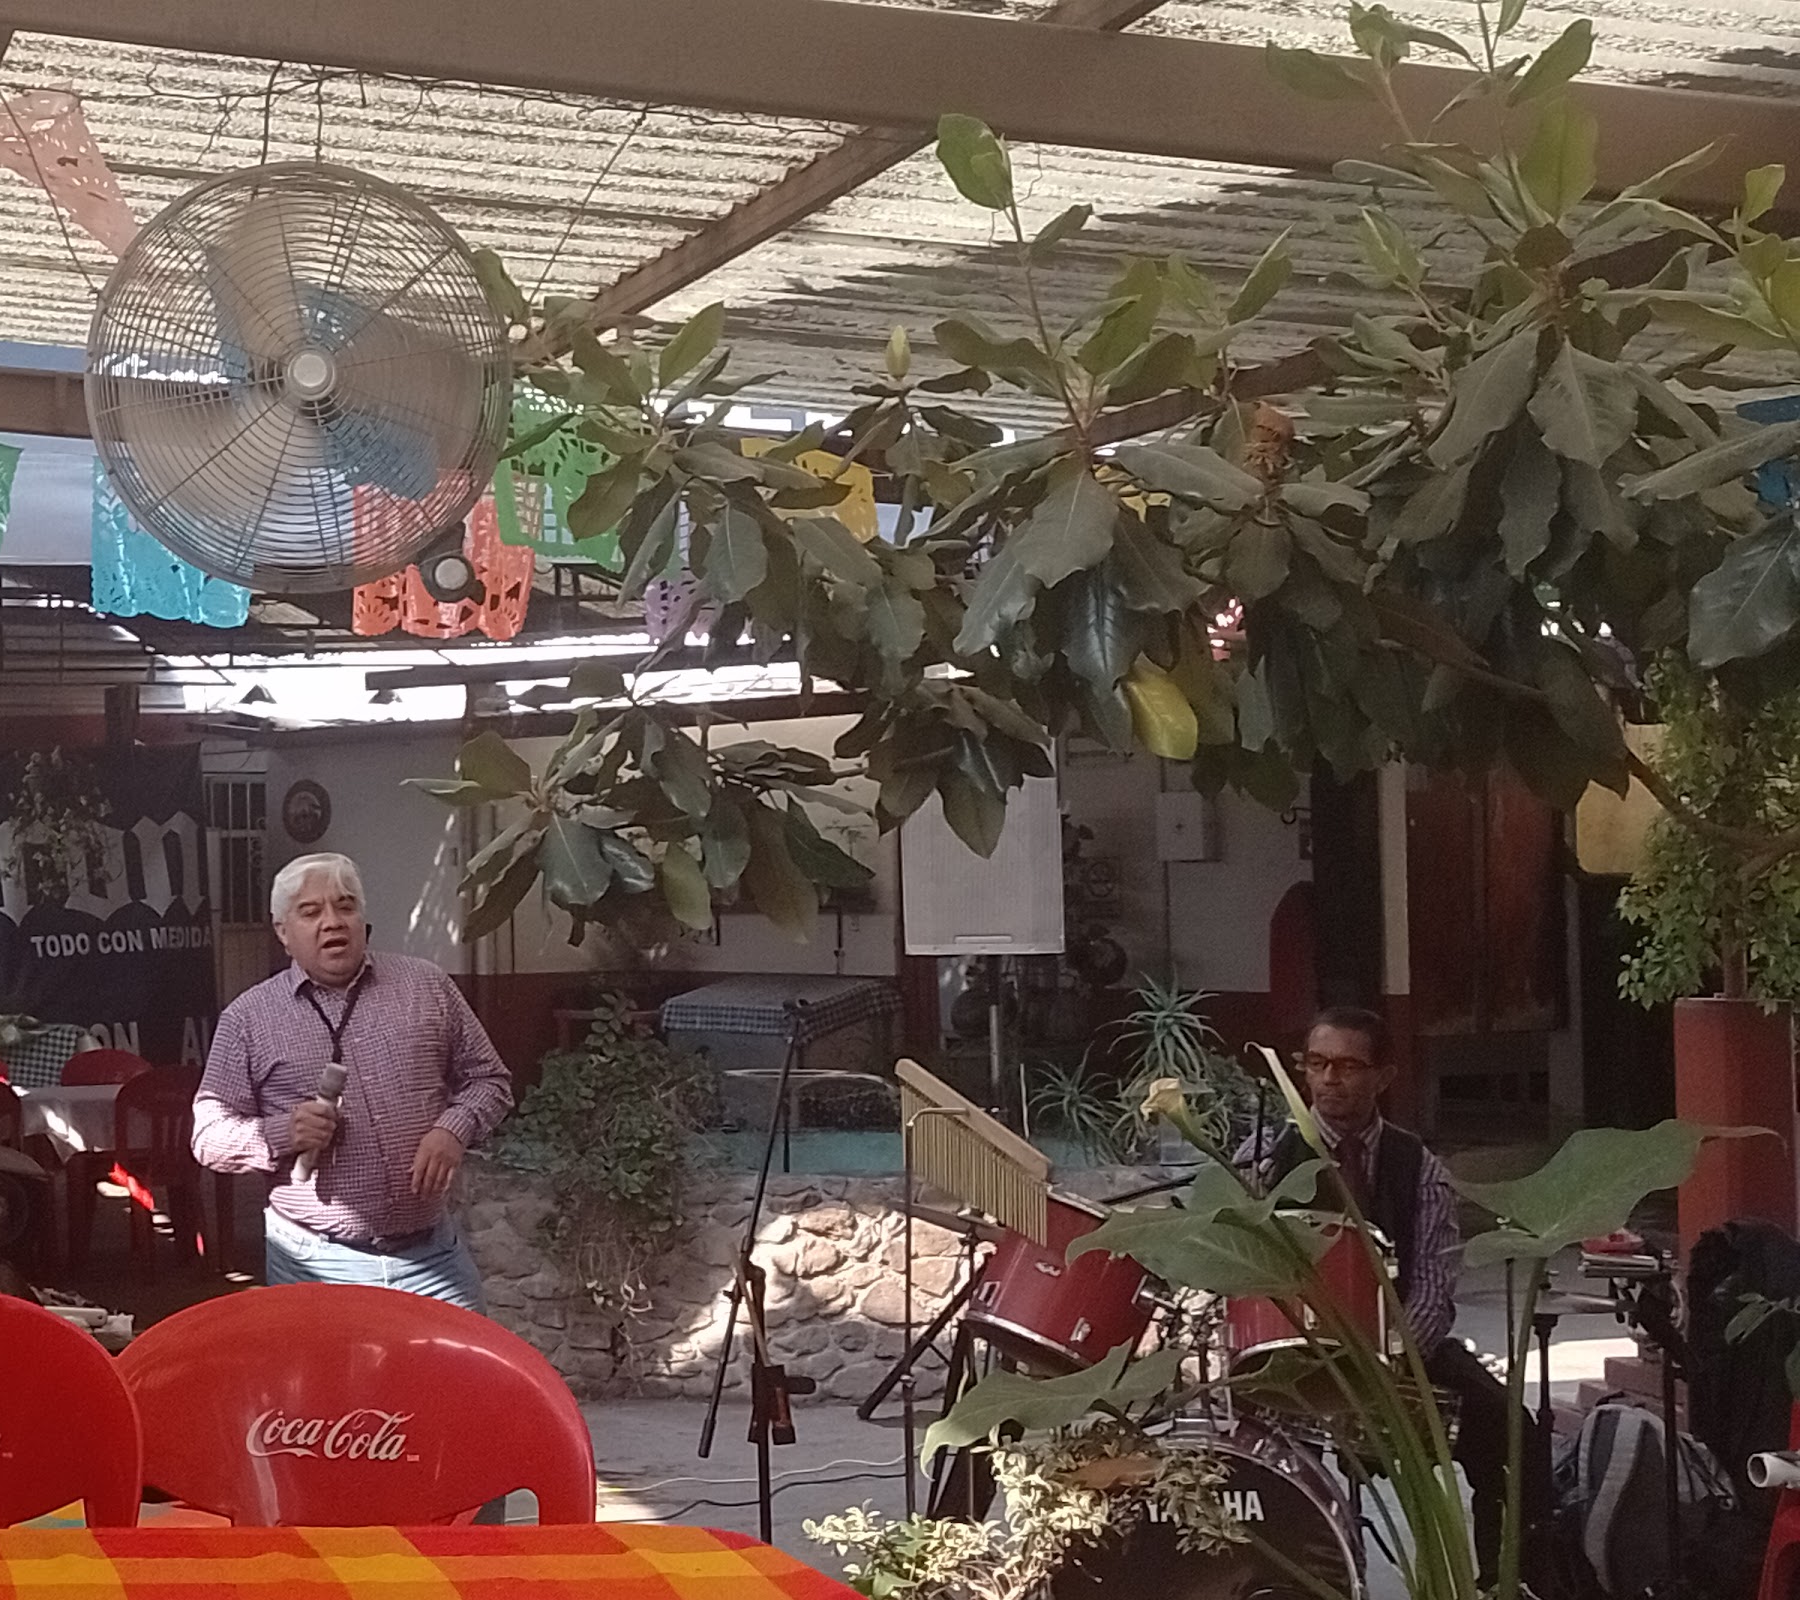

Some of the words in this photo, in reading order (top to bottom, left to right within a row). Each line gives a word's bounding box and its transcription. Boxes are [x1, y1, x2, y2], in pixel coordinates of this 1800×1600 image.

[30, 932, 91, 958] TODO
[97, 929, 144, 954] CON
[150, 926, 212, 950] MEDIDA
[246, 1408, 415, 1461] Coca-Cola
